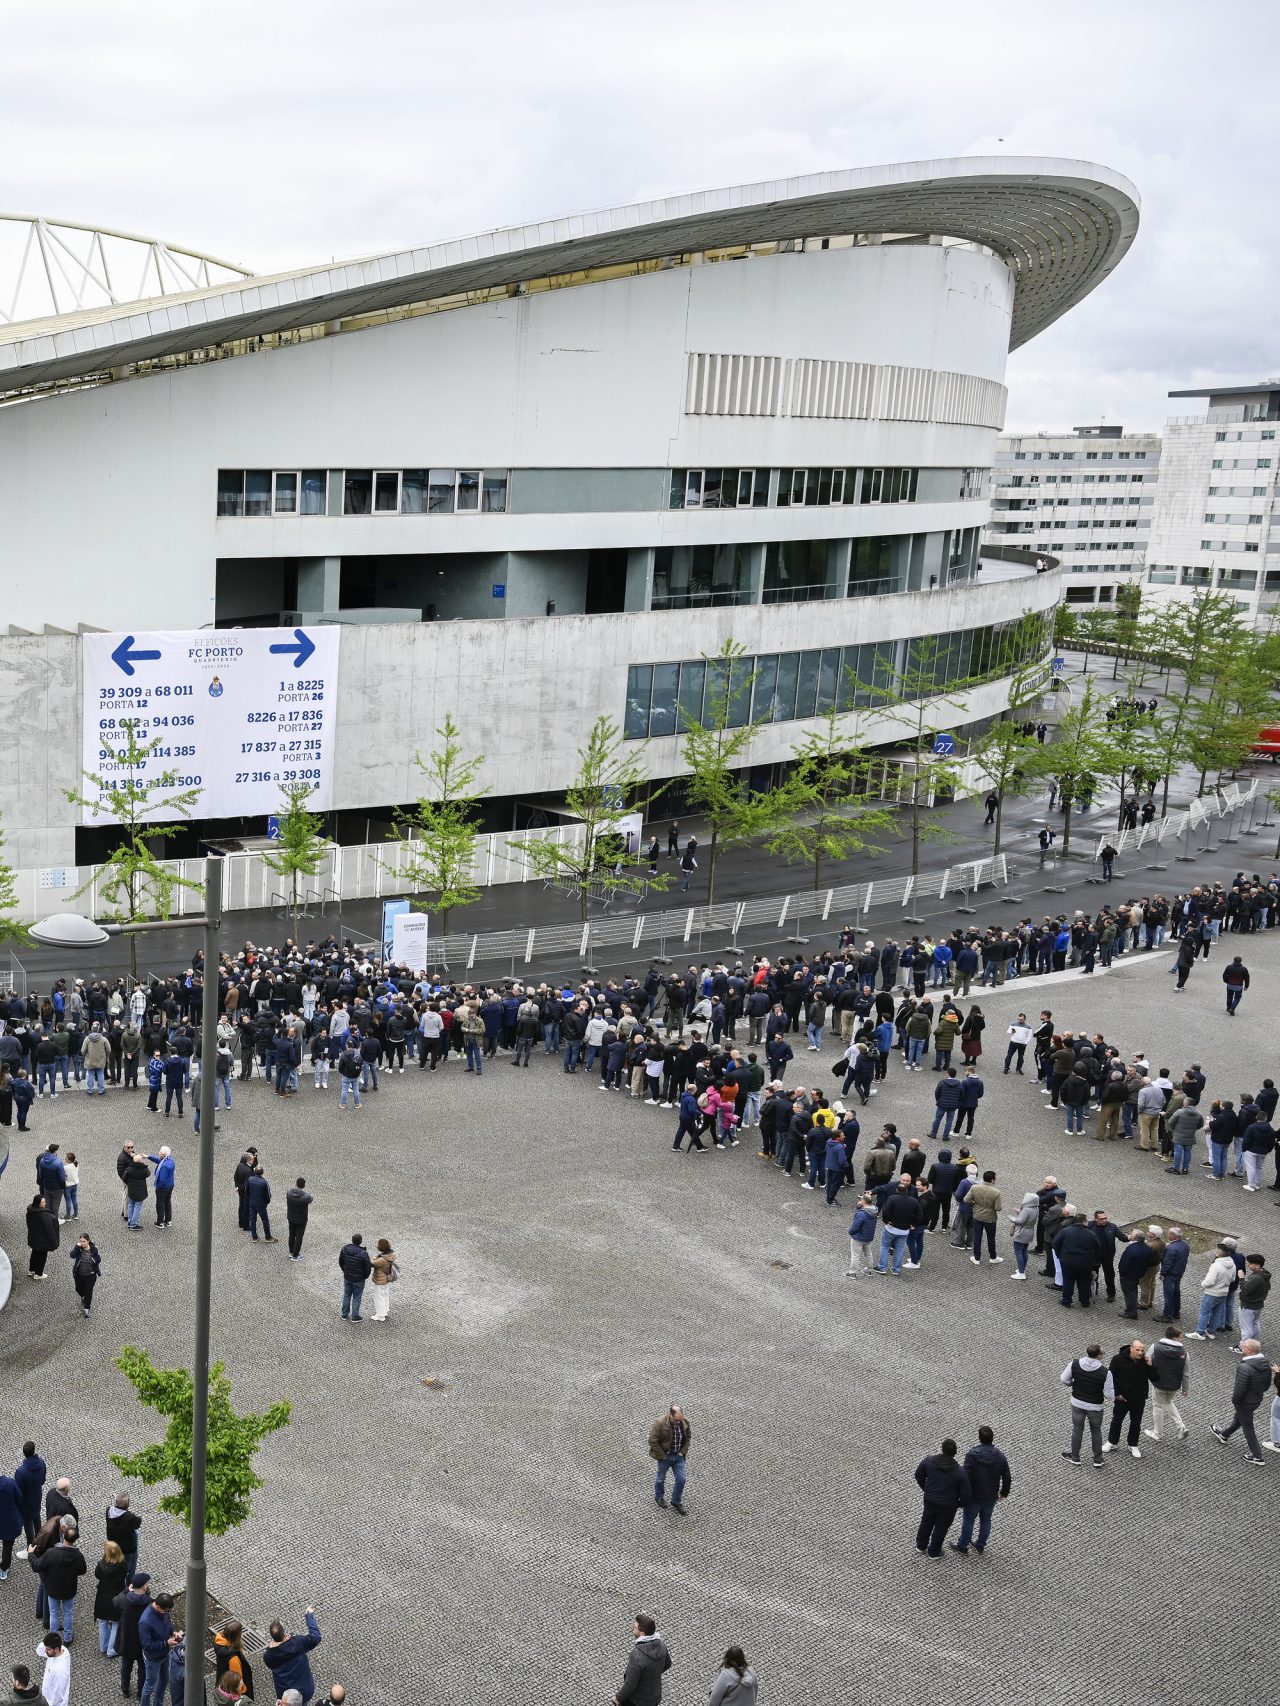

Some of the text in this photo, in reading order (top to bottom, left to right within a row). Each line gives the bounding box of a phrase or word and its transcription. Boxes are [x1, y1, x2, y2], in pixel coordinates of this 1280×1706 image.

[194, 636, 238, 647] ELEIÇÕES
[188, 647, 244, 658] FC PORTO
[1054, 663, 1064, 671] 03
[280, 682, 285, 692] 1
[297, 680, 324, 690] 8225
[99, 685, 193, 699] 39 309 a 68 011
[278, 692, 324, 702] PORTA 26
[99, 699, 148, 710] PORTA 12
[100, 719, 116, 729] 68
[143, 719, 150, 727] a
[153, 716, 168, 727] 94
[171, 715, 194, 726] 036
[247, 712, 276, 723] 8226
[288, 711, 300, 721] 17
[302, 710, 323, 720] 836
[278, 722, 322, 732] PORTA 27
[136, 730, 147, 738] 13
[241, 743, 252, 753] 17
[255, 742, 276, 752] 837
[288, 741, 302, 751] 27
[304, 740, 321, 750] 315
[937, 742, 954, 753] 27
[99, 750, 115, 760] 94
[153, 747, 171, 758] 114
[174, 746, 195, 756] 385
[282, 752, 321, 762] PORTA 3
[99, 761, 147, 771] PORTA 17
[236, 773, 249, 783] 27
[251, 771, 270, 782] 316
[283, 770, 297, 781] 39
[299, 769, 320, 779] 308
[99, 780, 117, 791] 114
[178, 776, 202, 786] 500
[282, 782, 311, 791] PORTA
[606, 795, 623, 808] 26
[271, 827, 286, 840] 2
